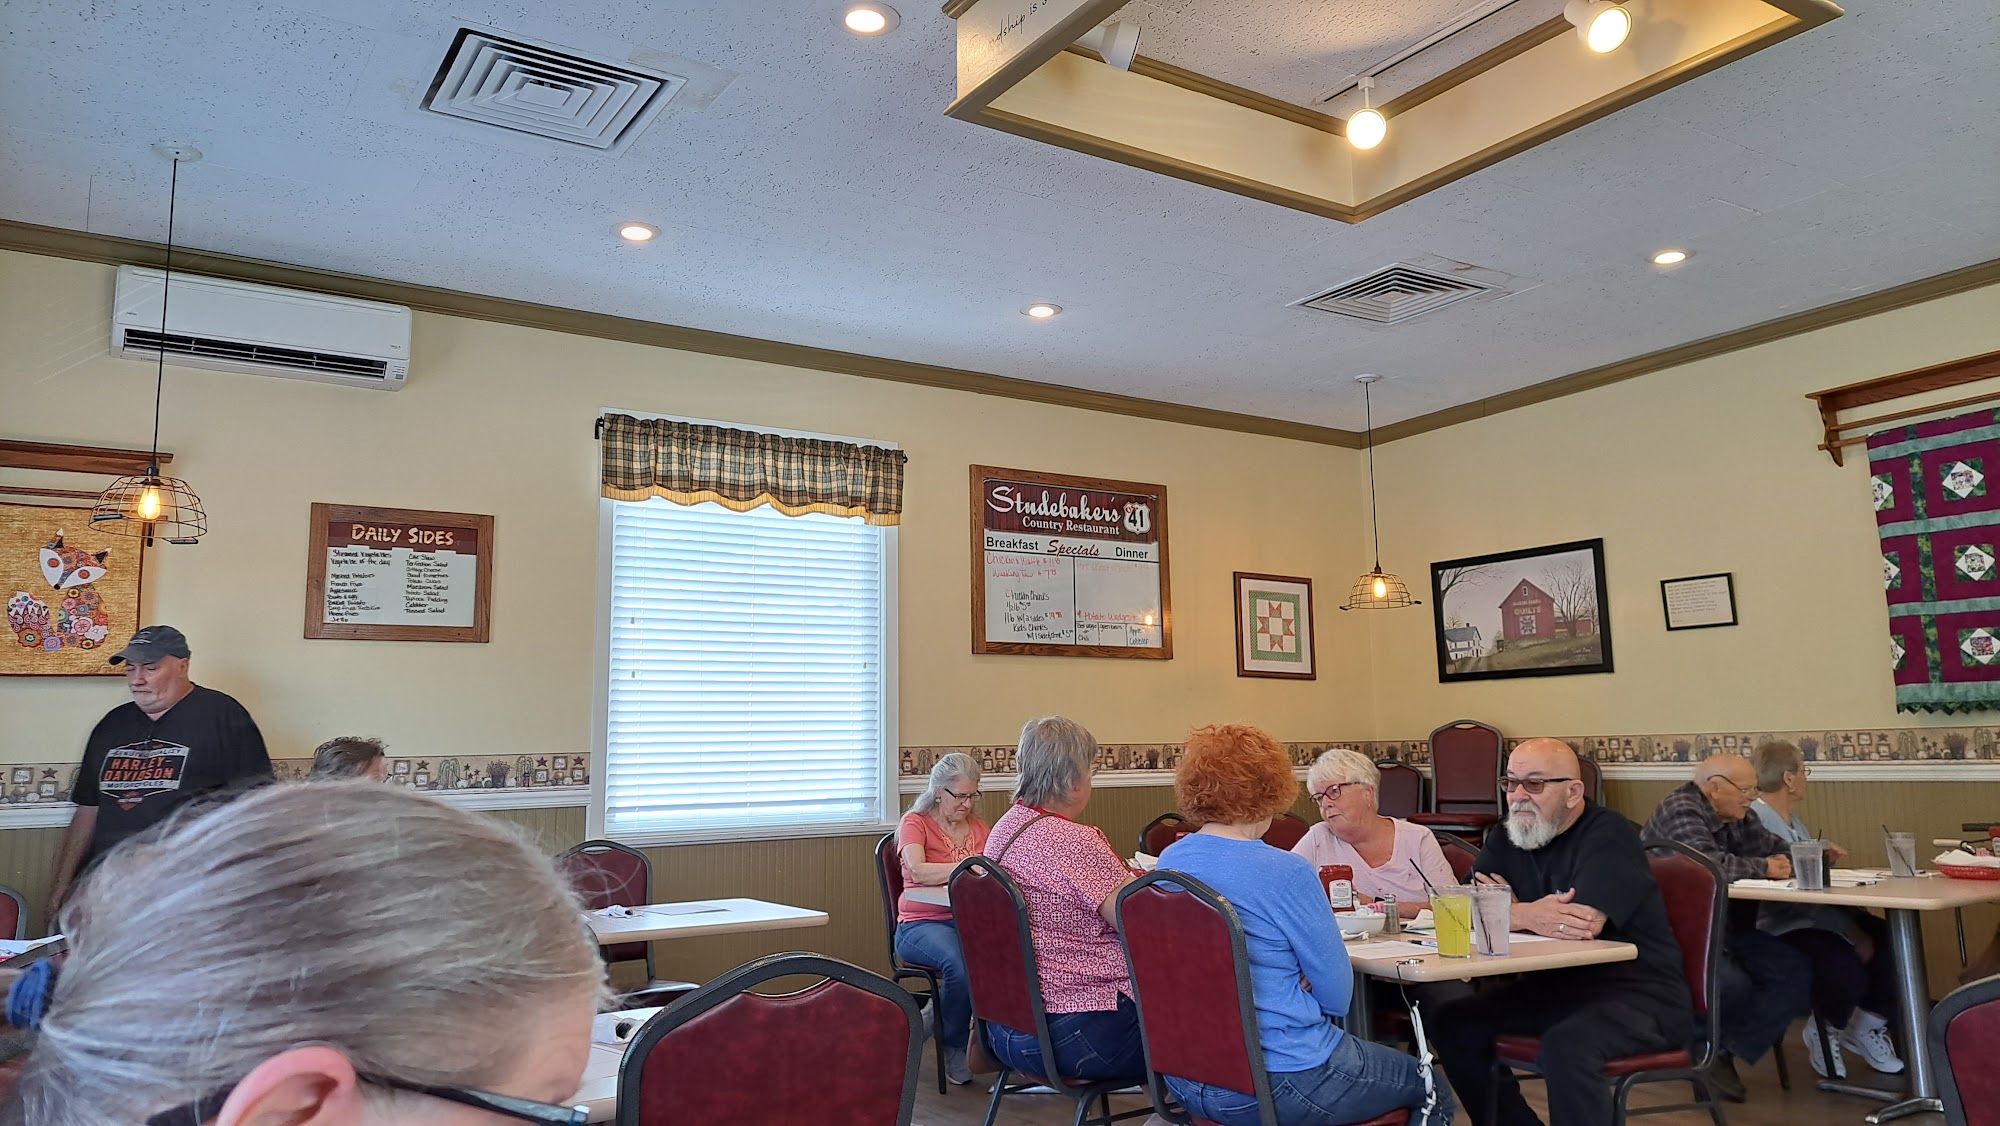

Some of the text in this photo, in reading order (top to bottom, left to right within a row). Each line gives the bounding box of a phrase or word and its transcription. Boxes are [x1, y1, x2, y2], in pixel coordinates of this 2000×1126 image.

[1029, 3, 1038, 16] is
[986, 486, 1122, 523] Studebaker's
[1022, 515, 1120, 535] Country Restaurant
[1128, 509, 1144, 528] 41
[408, 527, 454, 546] SIDES
[986, 536, 1039, 550] Breakfast
[1046, 539, 1100, 557] Specials
[1115, 547, 1148, 559] Dinner
[1513, 606, 1542, 616] QUILTS
[111, 756, 172, 770] HARLEY-
[103, 767, 174, 781] DAVIDSON
